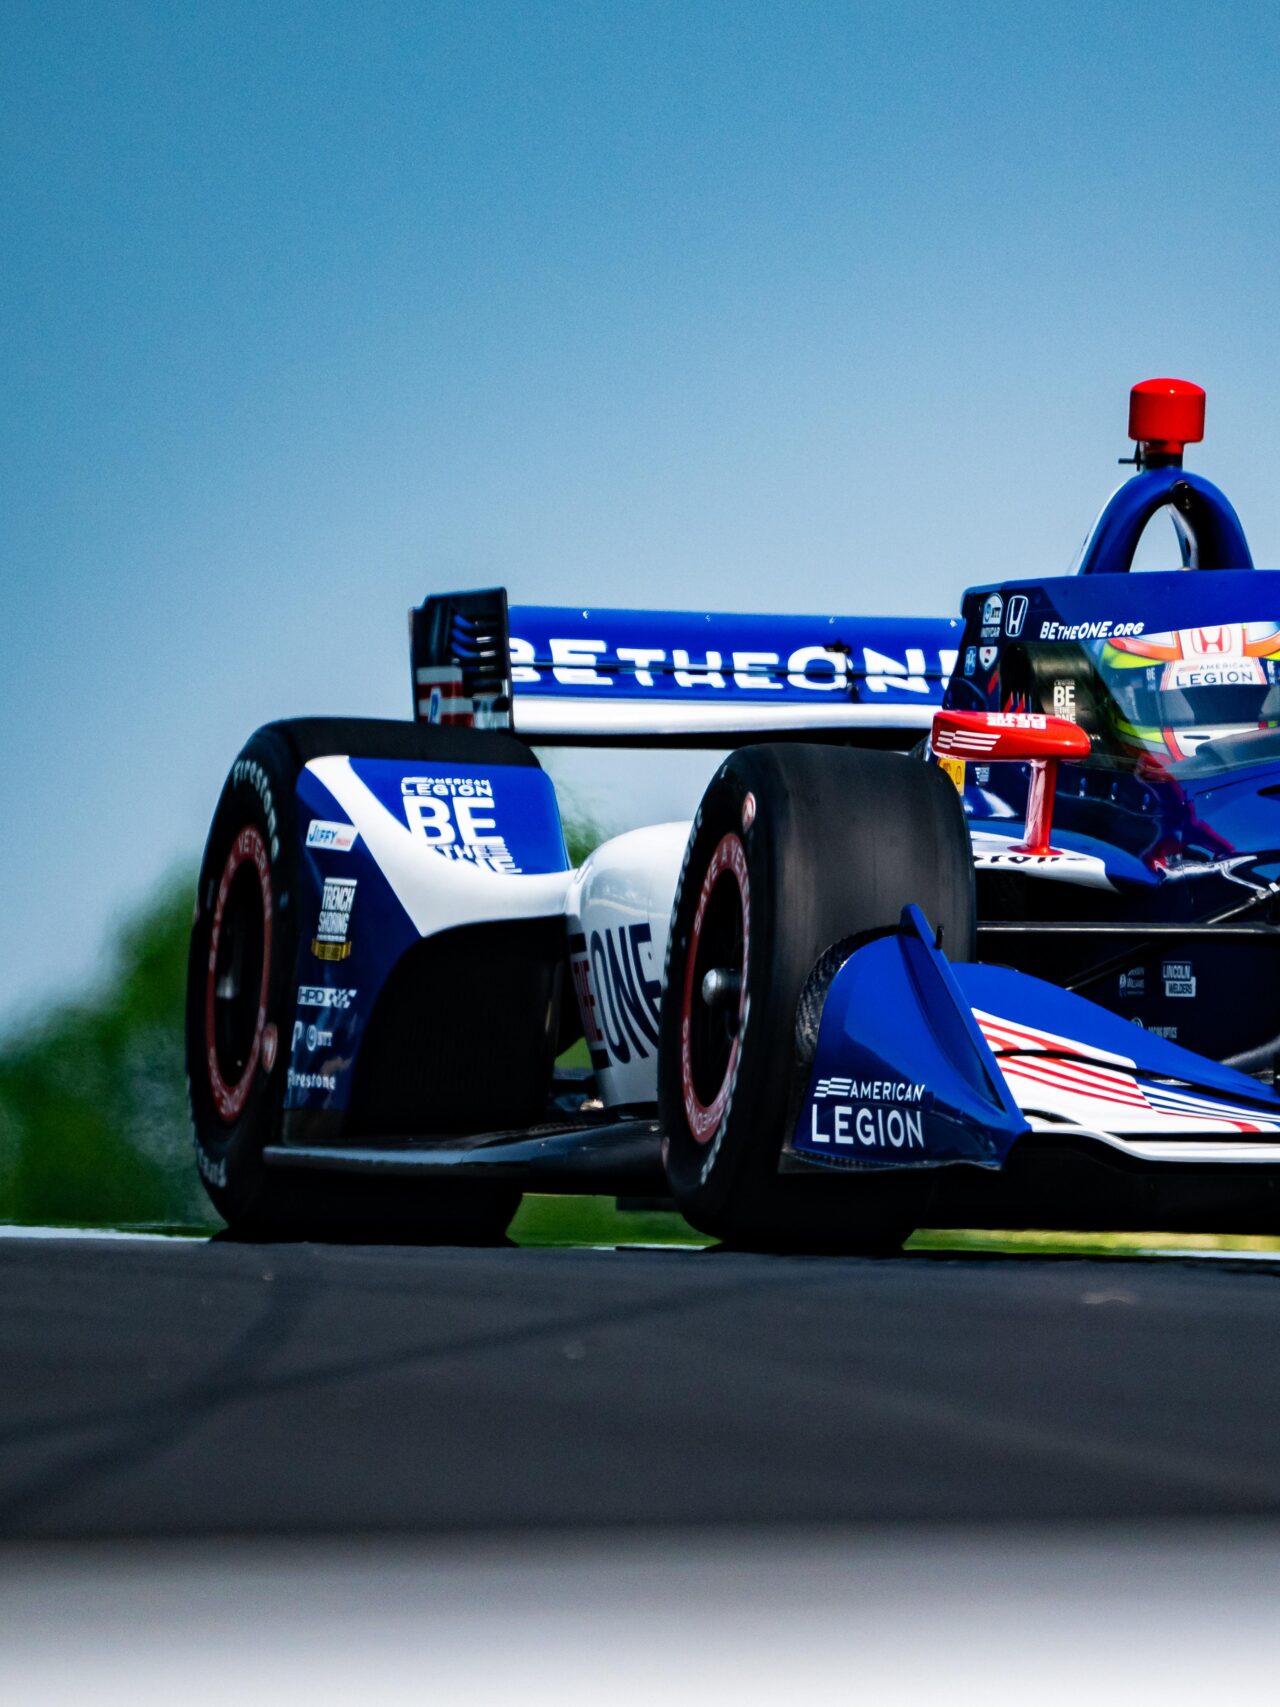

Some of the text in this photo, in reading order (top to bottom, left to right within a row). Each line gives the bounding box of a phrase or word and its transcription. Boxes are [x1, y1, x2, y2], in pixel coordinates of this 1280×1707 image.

[1176, 671, 1253, 687] LEGION
[1054, 686, 1076, 707] BE
[401, 782, 493, 797] LEGION
[403, 795, 505, 846] BE
[322, 886, 355, 912] TRENCH
[317, 910, 350, 934] SHORING
[1163, 964, 1191, 979] LINCOLN
[590, 922, 662, 1065] ONE
[849, 1080, 926, 1102] AMERICAN
[811, 1103, 925, 1149] LEGION
